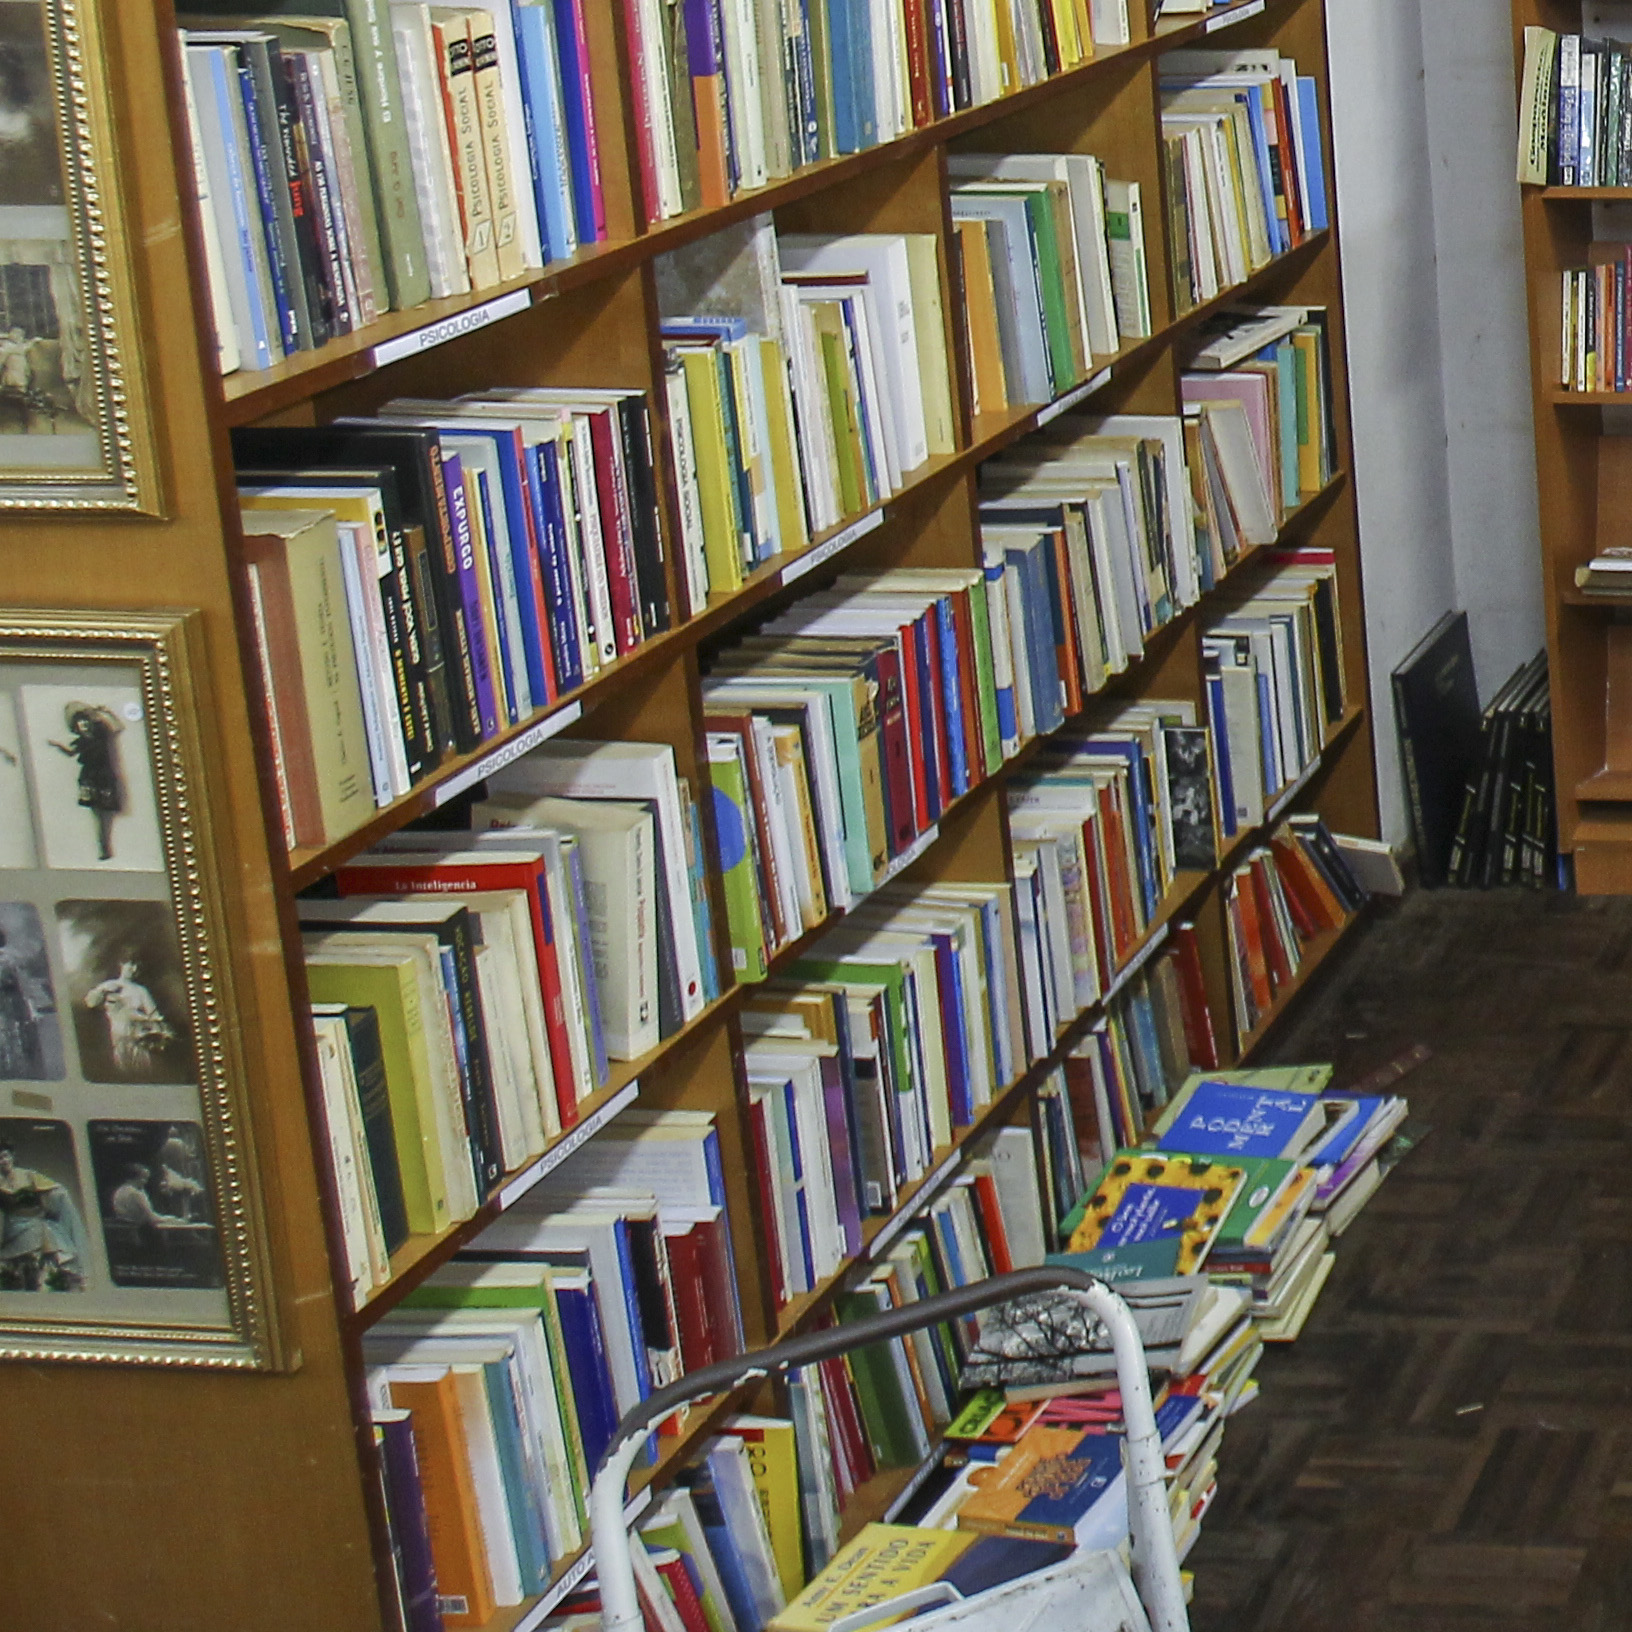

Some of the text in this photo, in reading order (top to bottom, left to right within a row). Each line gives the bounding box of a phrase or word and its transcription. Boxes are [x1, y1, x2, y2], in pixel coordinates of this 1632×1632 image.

[459, 84, 484, 218] PSICOLOGIA SOCIAL
[484, 80, 508, 213] PSICOLOGIA SOCIAL
[418, 309, 492, 348] PSICOLOGIA
[451, 484, 474, 570] EXPURGO
[476, 728, 545, 779] PSICOLOGIA
[411, 879, 477, 893] Inteligencia
[838, 1537, 910, 1600] SENTIDO
[900, 1539, 937, 1575] VIDA
